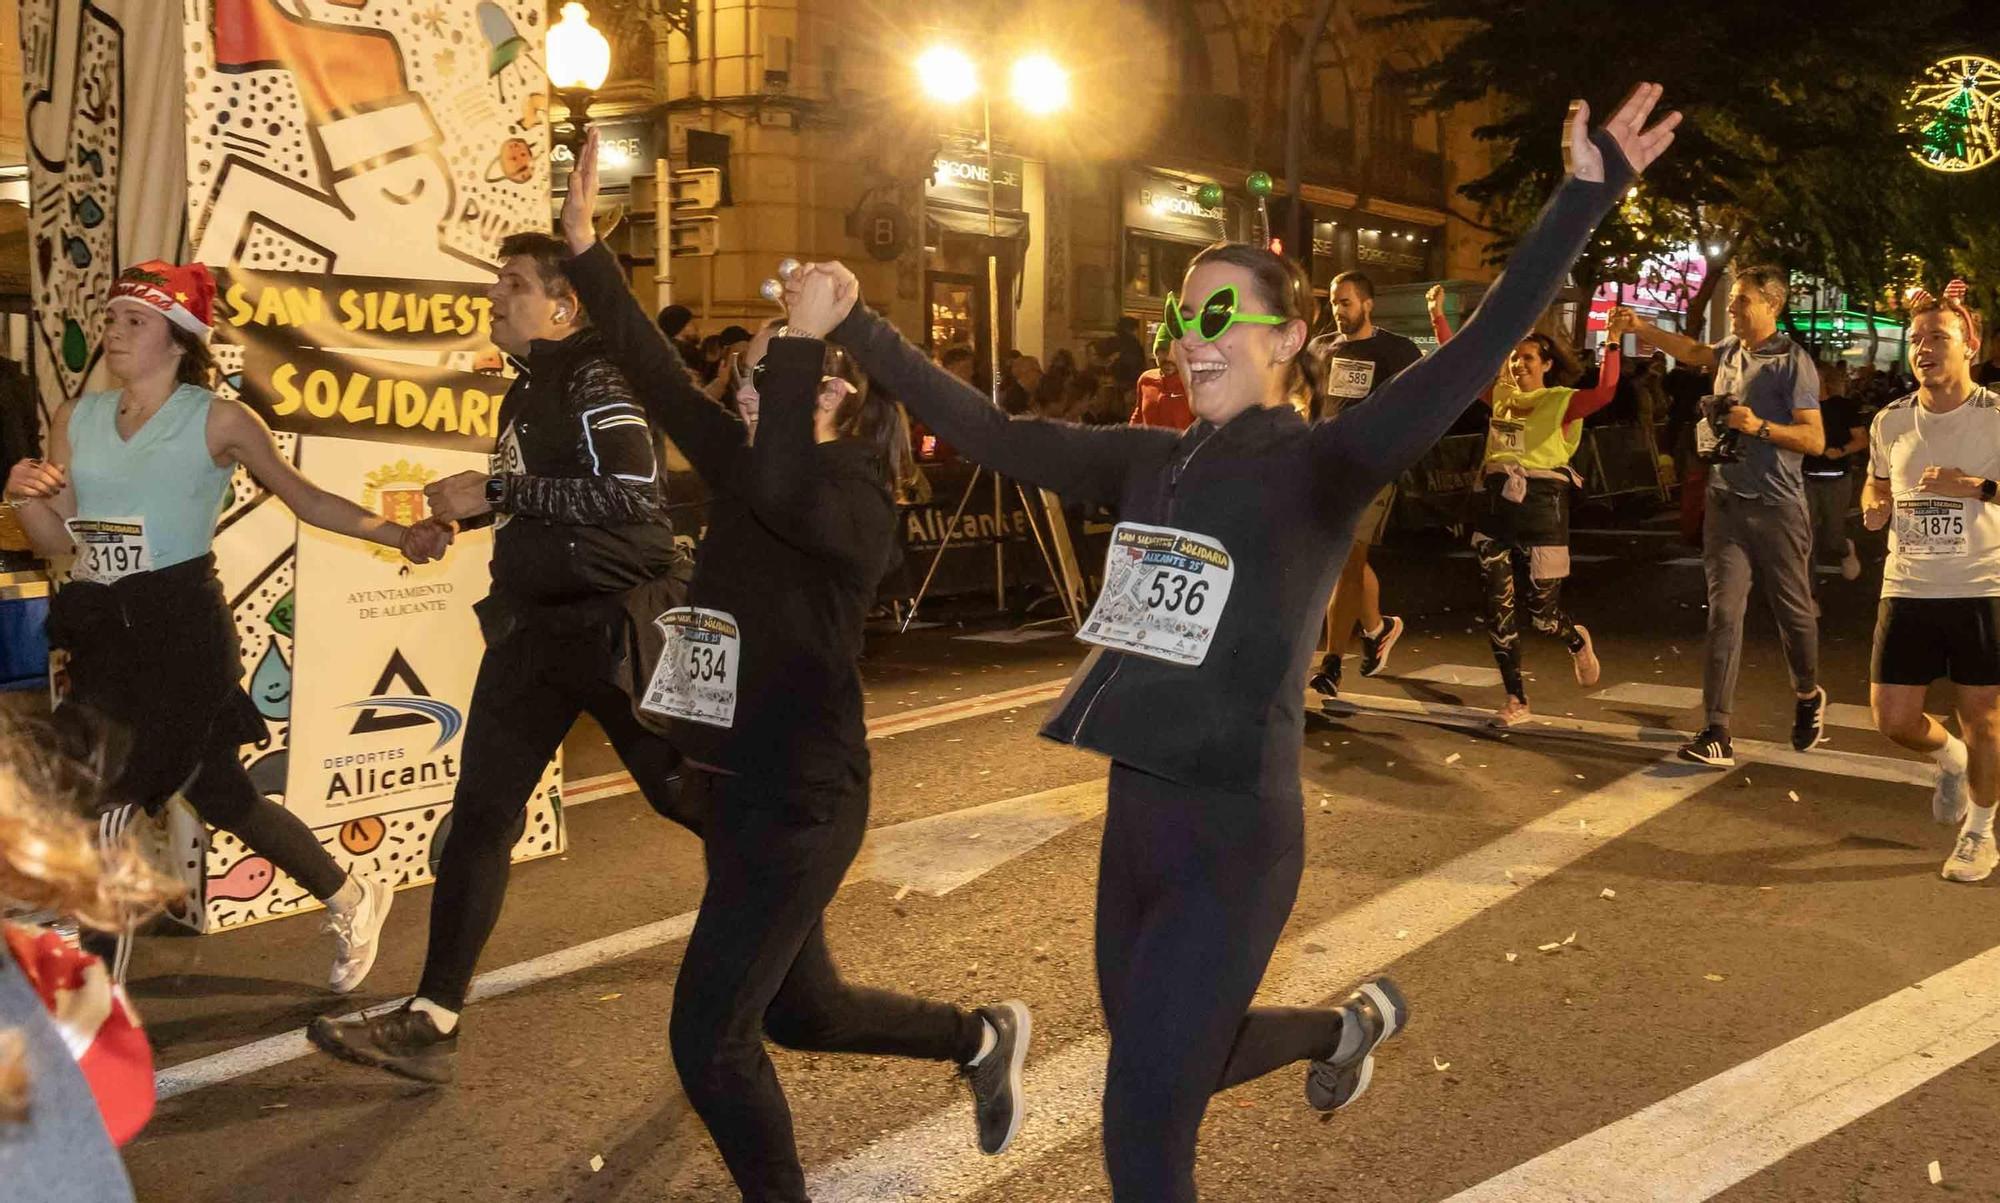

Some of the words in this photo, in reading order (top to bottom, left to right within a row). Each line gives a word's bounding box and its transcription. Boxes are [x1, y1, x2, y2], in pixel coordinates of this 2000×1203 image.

[875, 218, 894, 245] B
[225, 283, 323, 328] SAN
[1348, 371, 1368, 385] 589
[1506, 433, 1516, 447] 70
[1921, 516, 1964, 536] 1875
[89, 545, 143, 571] 3197
[1118, 531, 1136, 542] SAN
[1180, 541, 1228, 567] SOLIDARIA
[347, 582, 454, 604] AYUNTAMIENTO
[1148, 570, 1210, 616] 536
[360, 607, 379, 619] DE
[383, 600, 447, 617] ALICANTE
[690, 646, 726, 683] 534
[324, 748, 405, 770] DEPORTES
